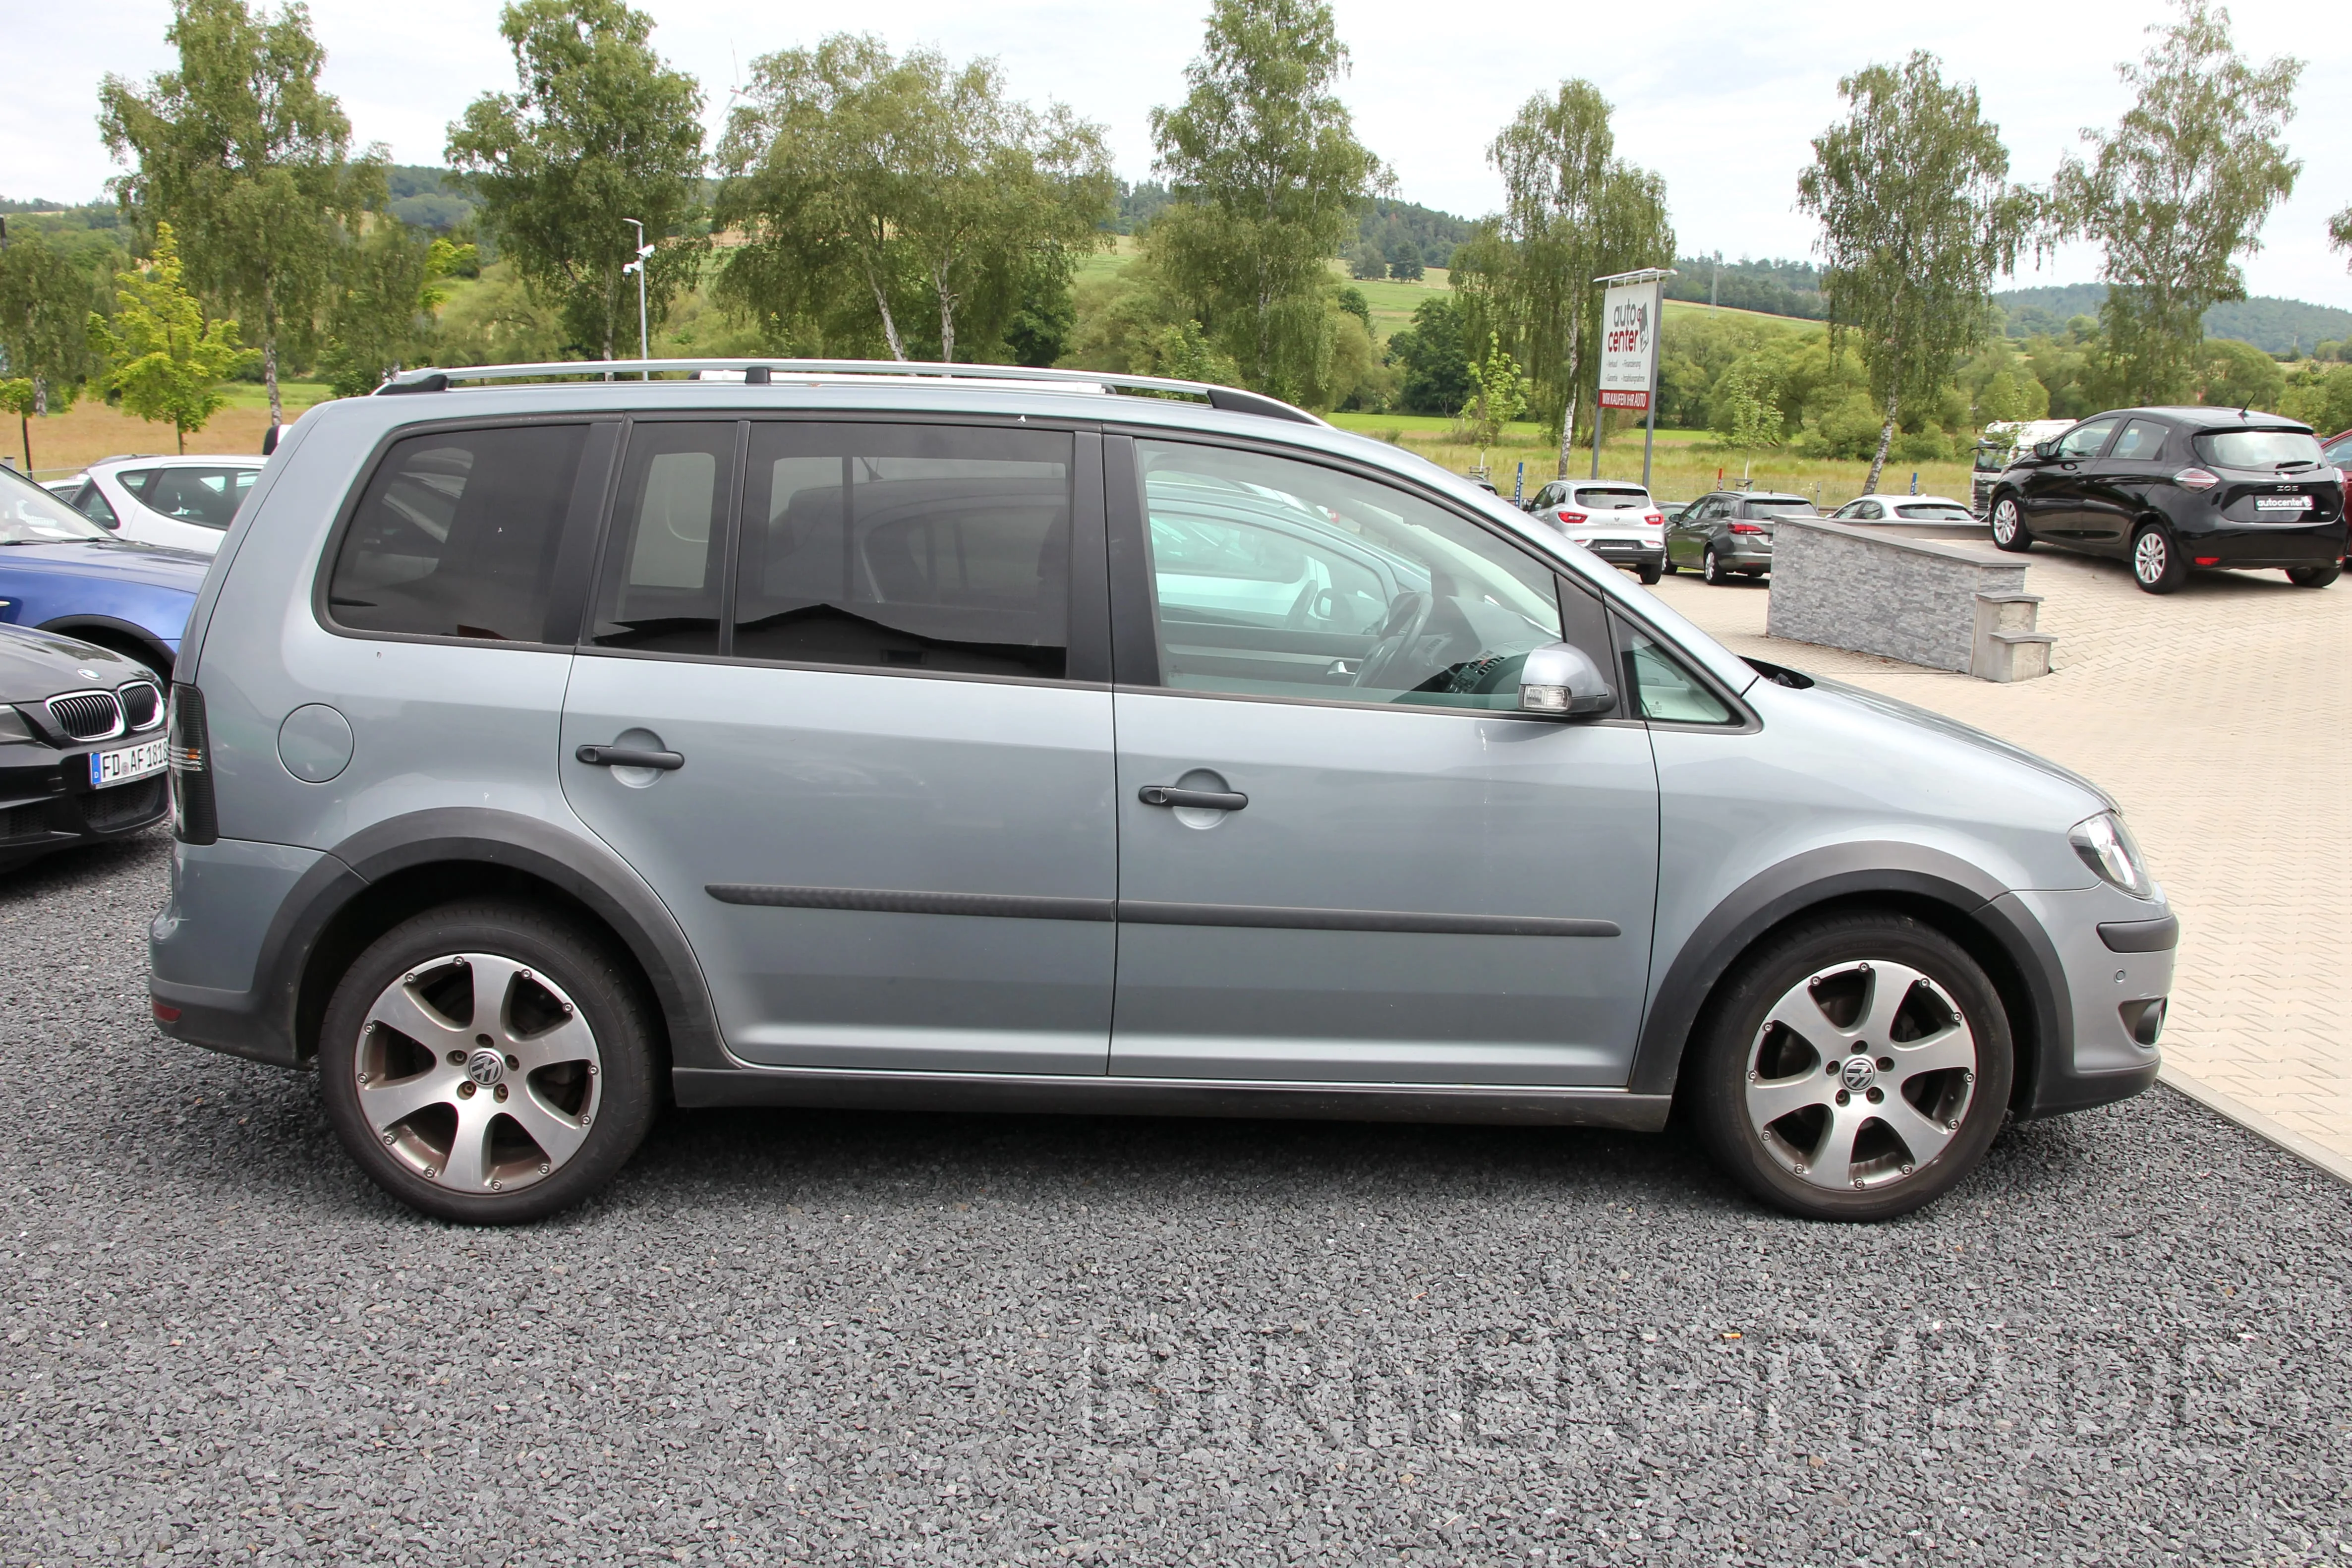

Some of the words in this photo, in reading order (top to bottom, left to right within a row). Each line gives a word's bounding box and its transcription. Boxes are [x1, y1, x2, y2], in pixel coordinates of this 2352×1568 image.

[1613, 298, 1636, 328] auto
[1607, 326, 1639, 353] center
[1602, 392, 1610, 405] WIR
[1610, 393, 1626, 406] KAUFEN
[1634, 393, 1646, 407] AUTO
[2257, 498, 2302, 507] autocenter
[103, 753, 120, 778] FD
[130, 748, 144, 772] AF
[146, 741, 168, 767] 1818
